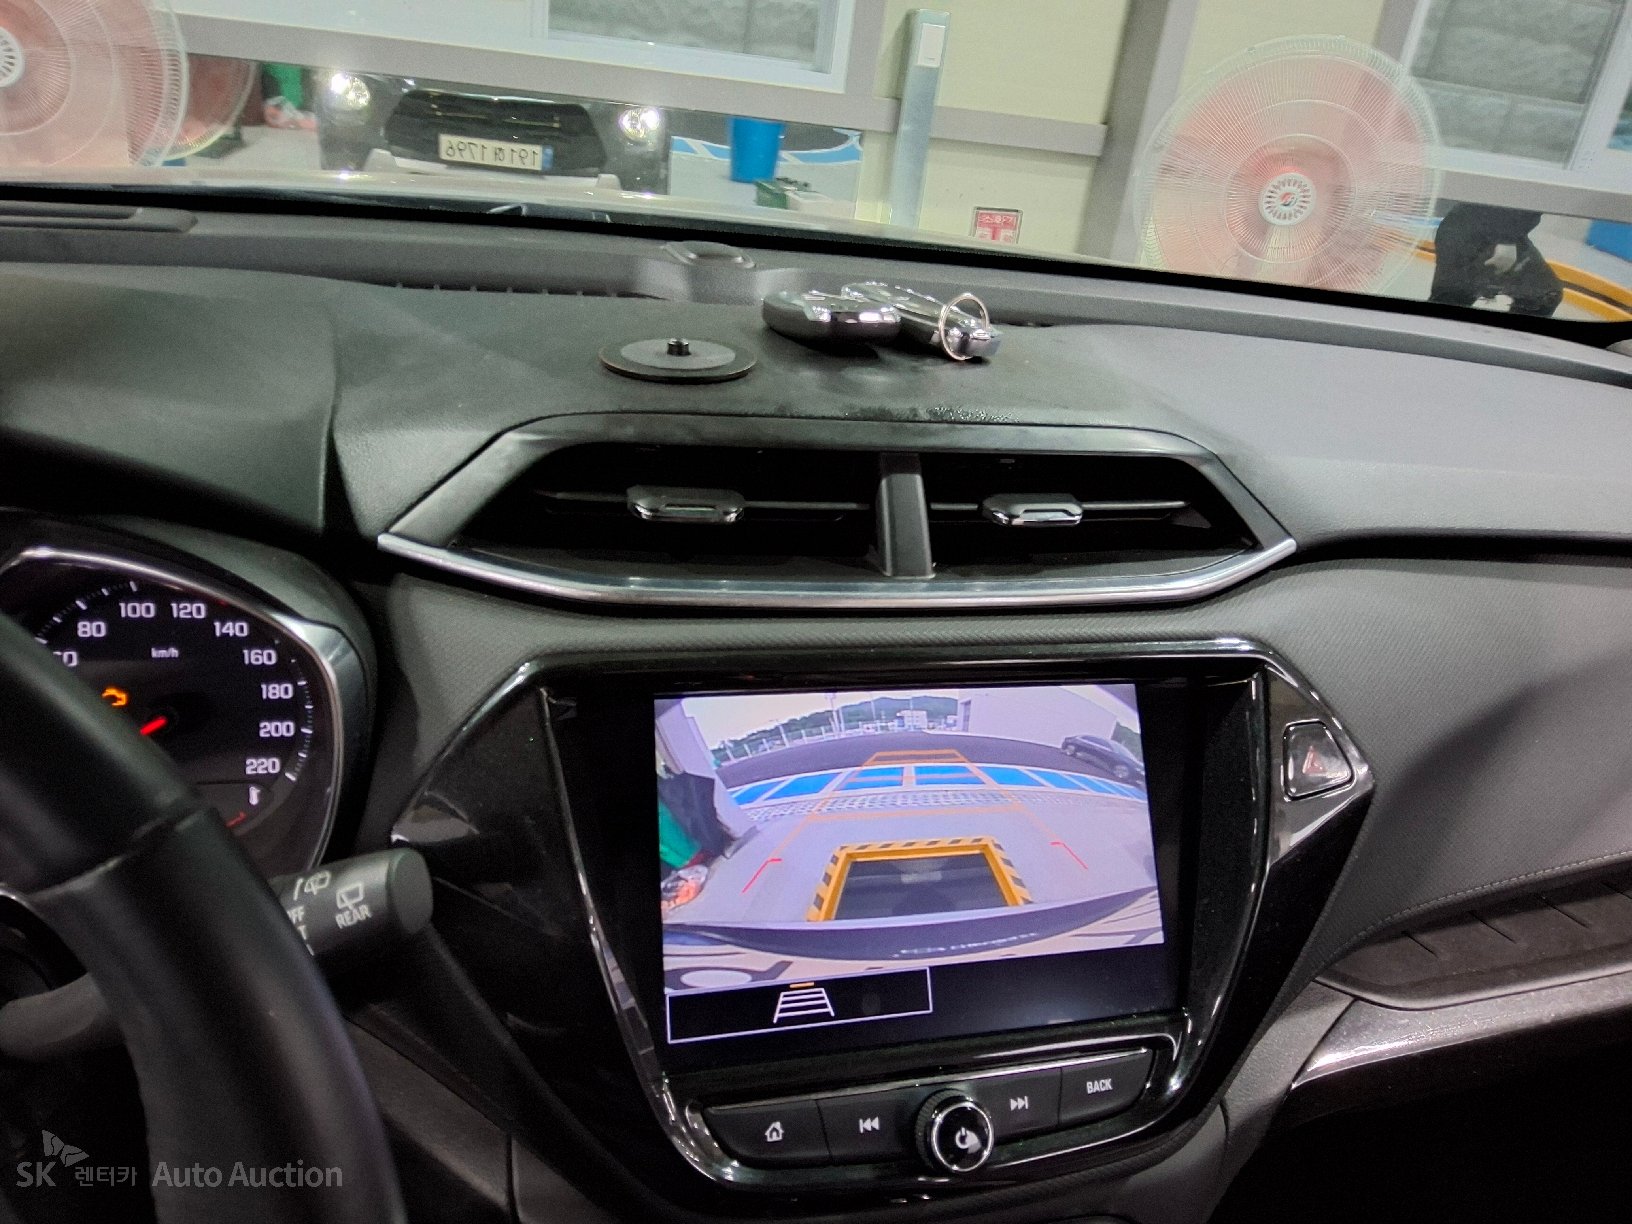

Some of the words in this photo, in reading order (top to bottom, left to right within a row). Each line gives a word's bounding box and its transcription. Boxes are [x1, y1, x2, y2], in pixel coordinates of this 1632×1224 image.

[119, 602, 156, 619] 100
[170, 602, 207, 619] 120
[77, 621, 107, 638] 80
[213, 621, 249, 638] 140
[53, 650, 78, 667] 0
[151, 647, 179, 659] km/h
[243, 649, 278, 665] 160
[261, 683, 294, 700] 180
[259, 721, 296, 738] 200
[245, 758, 281, 775] 220
[335, 905, 372, 929] REAR
[1086, 1078, 1113, 1094] BACK
